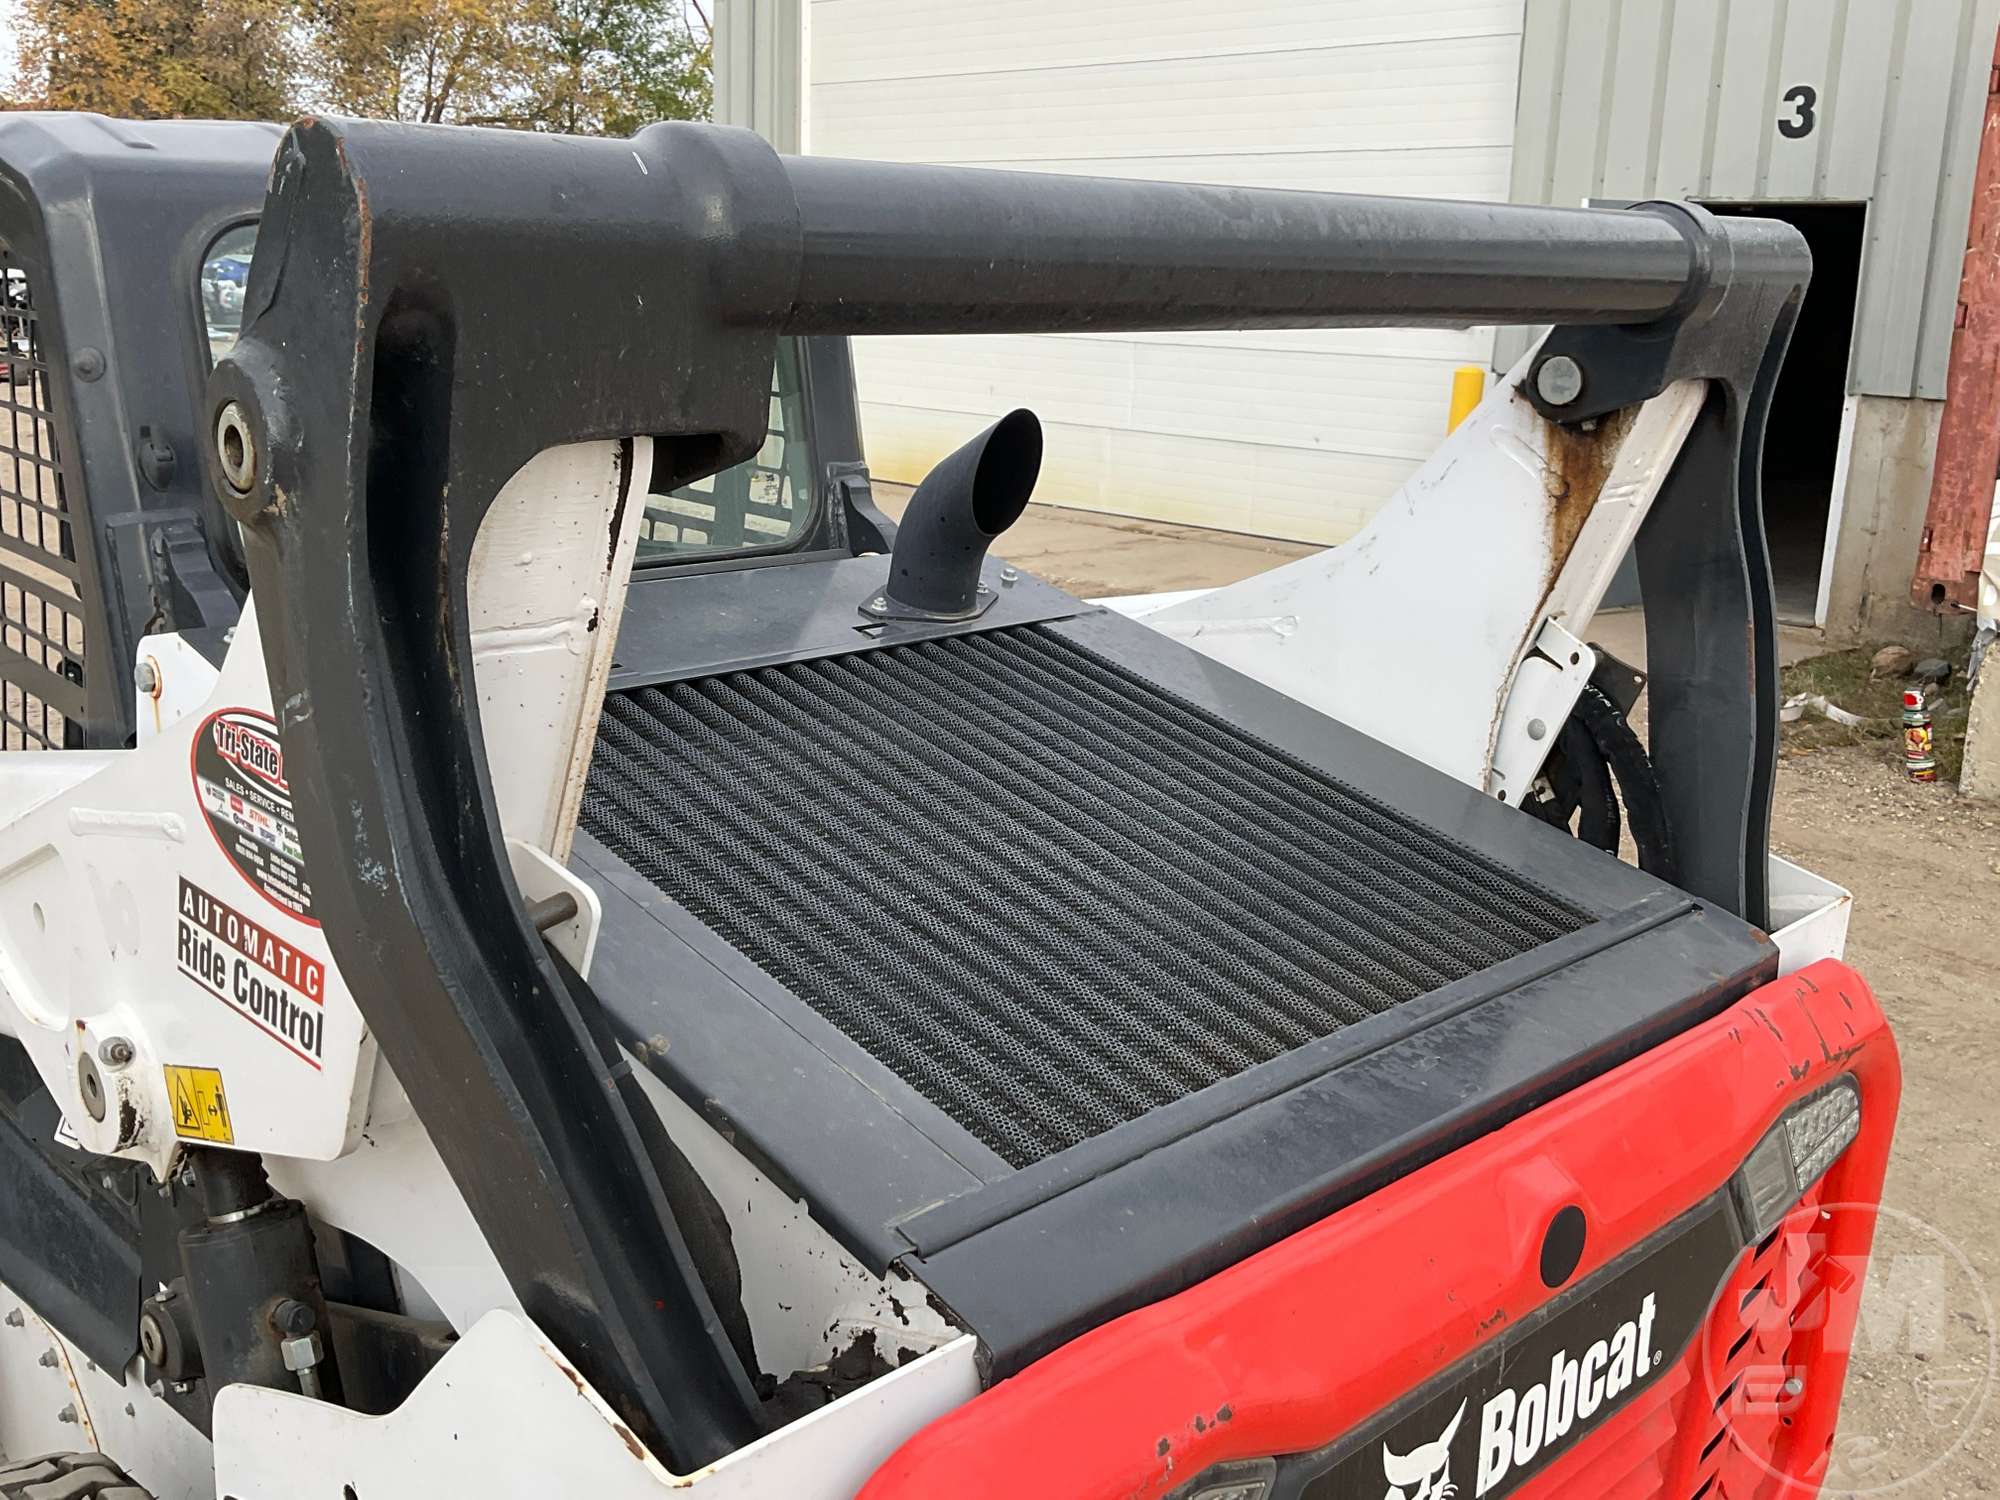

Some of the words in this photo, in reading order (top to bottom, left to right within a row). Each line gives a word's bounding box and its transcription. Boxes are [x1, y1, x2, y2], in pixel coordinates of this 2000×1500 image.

[1778, 86, 1816, 138] 3
[217, 721, 278, 775] Tri-State
[225, 777, 245, 795] SALES
[249, 790, 276, 812] SERVICE
[281, 807, 295, 822] REN
[183, 886, 320, 996] AUTOMATIC
[178, 918, 226, 990] Ride
[233, 956, 324, 1059] Control
[1475, 1291, 1656, 1499] Bobcat
